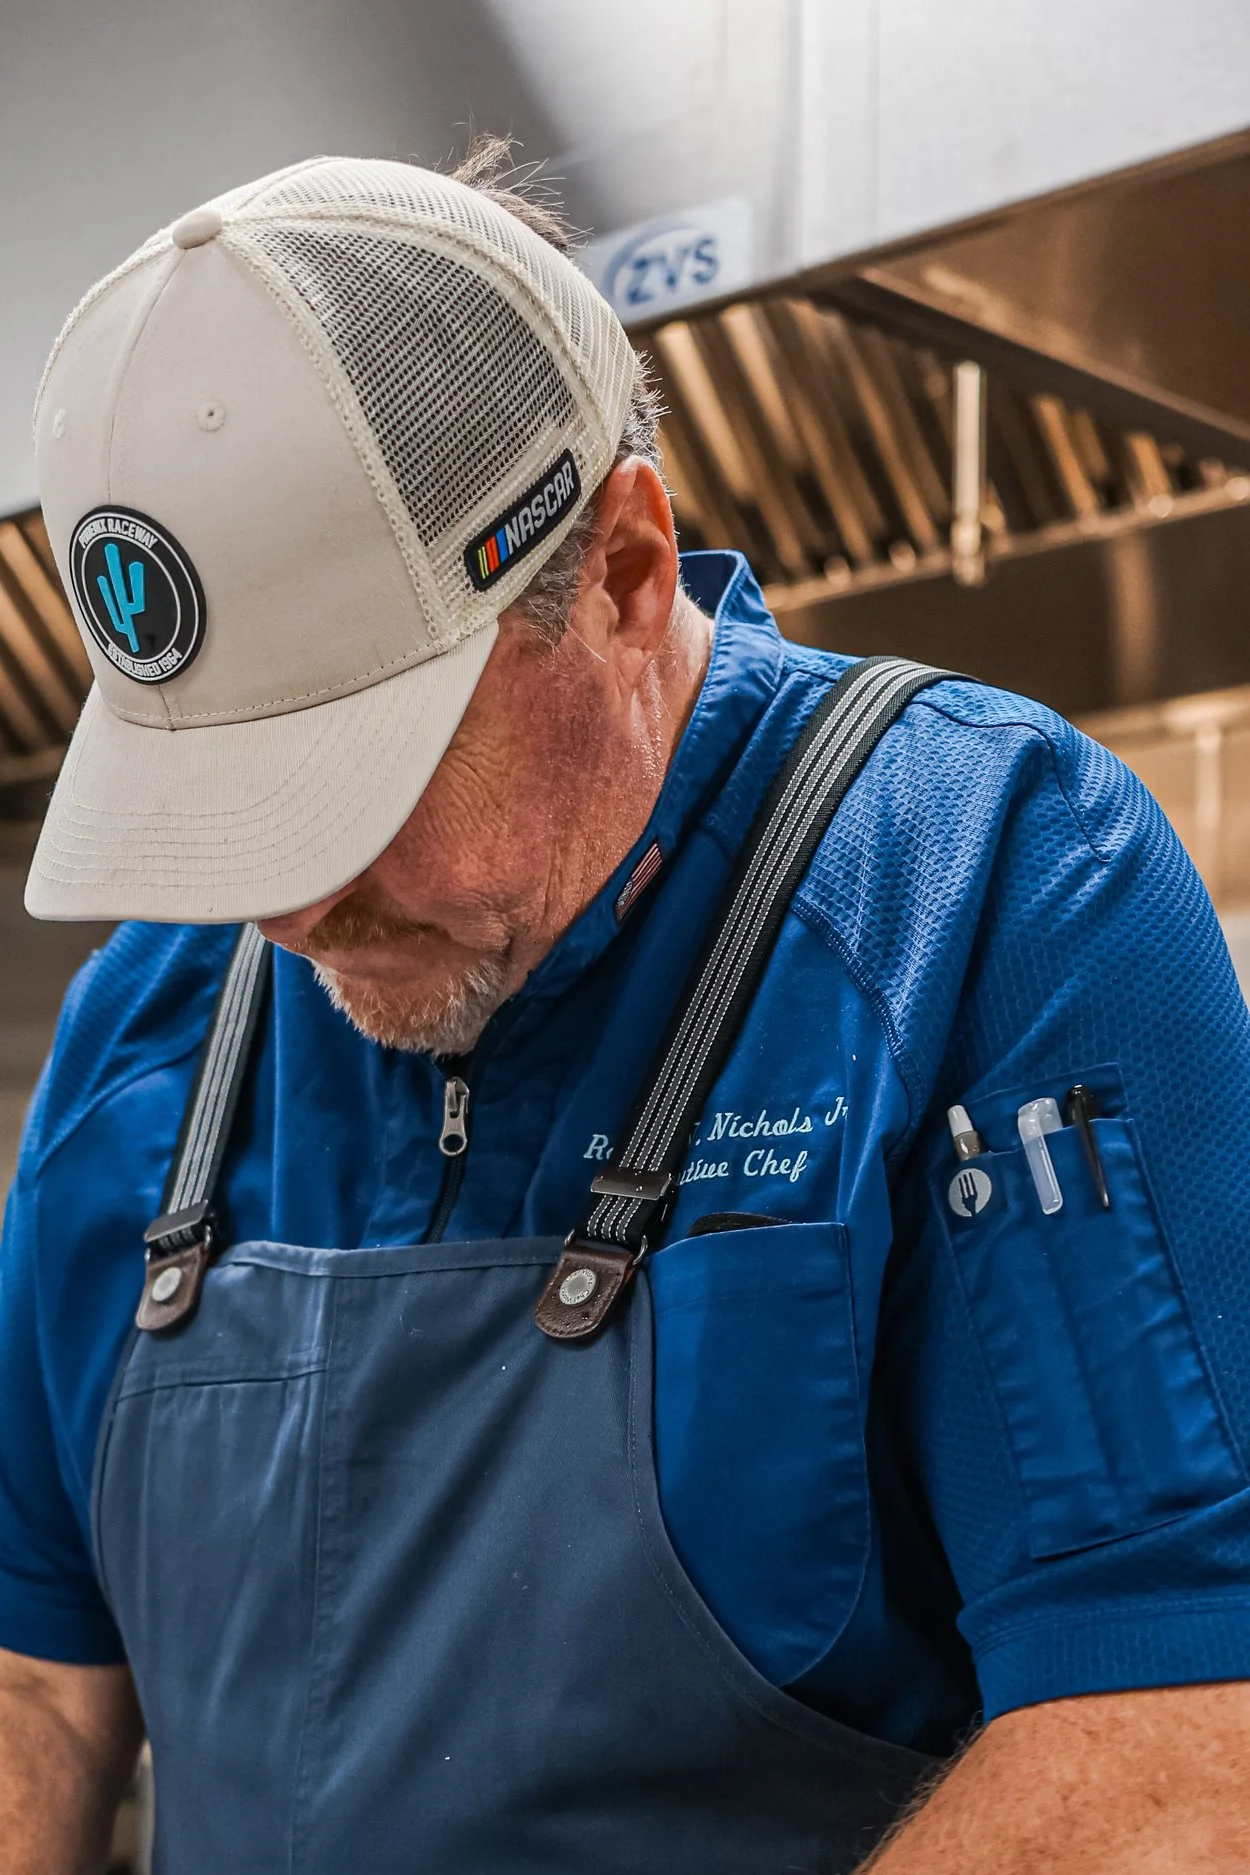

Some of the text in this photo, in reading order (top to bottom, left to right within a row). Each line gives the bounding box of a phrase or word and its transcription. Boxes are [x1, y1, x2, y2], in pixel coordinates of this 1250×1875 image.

[504, 460, 575, 556] NASCAR
[78, 518, 159, 549] PHOENIX RACEWAY
[107, 643, 183, 677] ESTABLISHED 1964
[706, 1107, 813, 1142] Nichols
[678, 1149, 808, 1186] utive Chef
